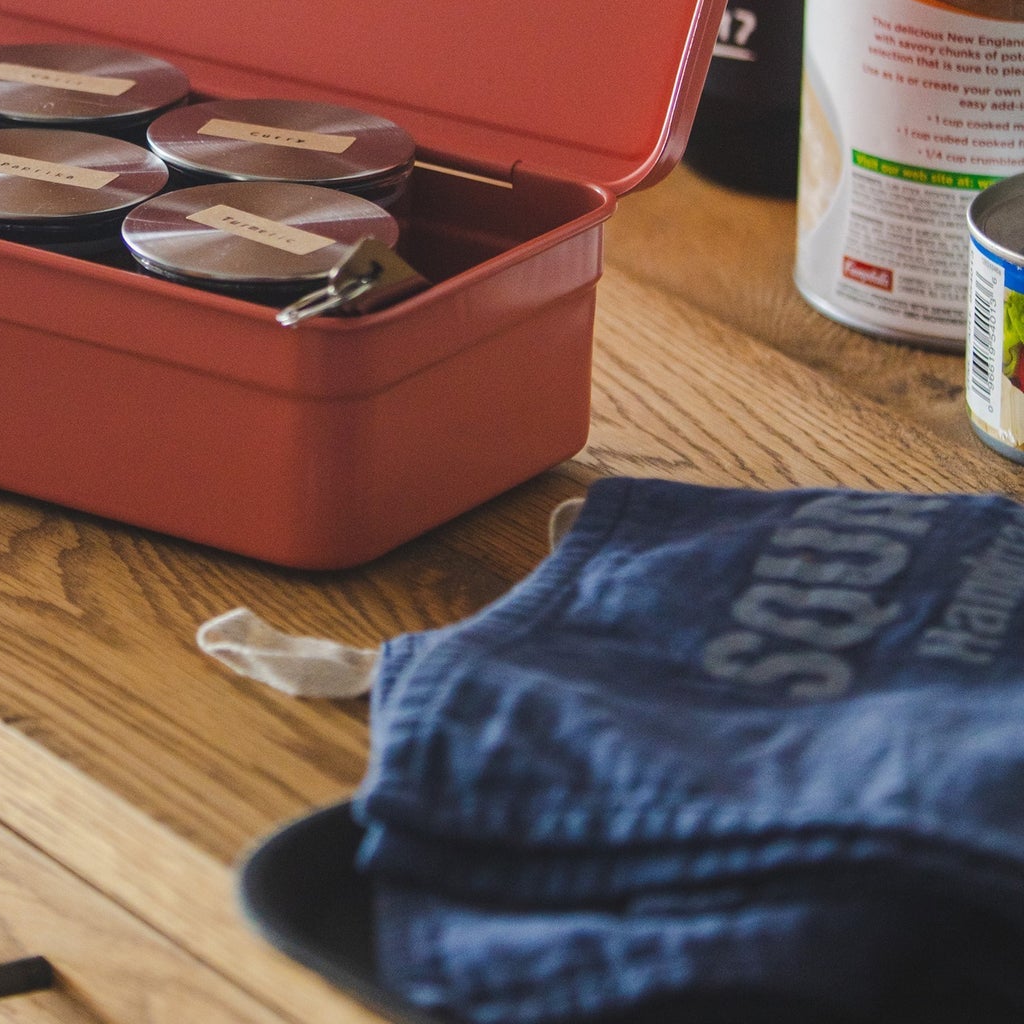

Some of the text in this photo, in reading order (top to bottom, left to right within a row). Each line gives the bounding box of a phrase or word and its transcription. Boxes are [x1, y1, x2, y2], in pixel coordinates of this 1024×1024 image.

[894, 23, 944, 40] delicious
[947, 33, 974, 44] New
[875, 33, 895, 46] with
[899, 40, 935, 55] savory
[939, 46, 981, 60] chunks
[985, 50, 997, 60] of
[917, 57, 939, 69] that
[943, 61, 952, 71] is
[956, 64, 981, 74] sure
[986, 65, 998, 75] to
[896, 72, 904, 82] is
[907, 76, 918, 85] or
[922, 79, 959, 93] create
[963, 86, 991, 96] your
[995, 88, 1021, 97] own
[959, 99, 987, 111] easy
[942, 119, 964, 128] cup
[966, 120, 1010, 131] cooked
[250, 131, 306, 144] Curry
[911, 131, 931, 141] cup
[933, 135, 969, 146] cubed
[972, 138, 1015, 149] cooked
[925, 149, 943, 160] 1/4
[946, 155, 967, 164] cup
[932, 173, 953, 184] site
[222, 216, 295, 244] Turmeric
[988, 298, 996, 343] 54013
